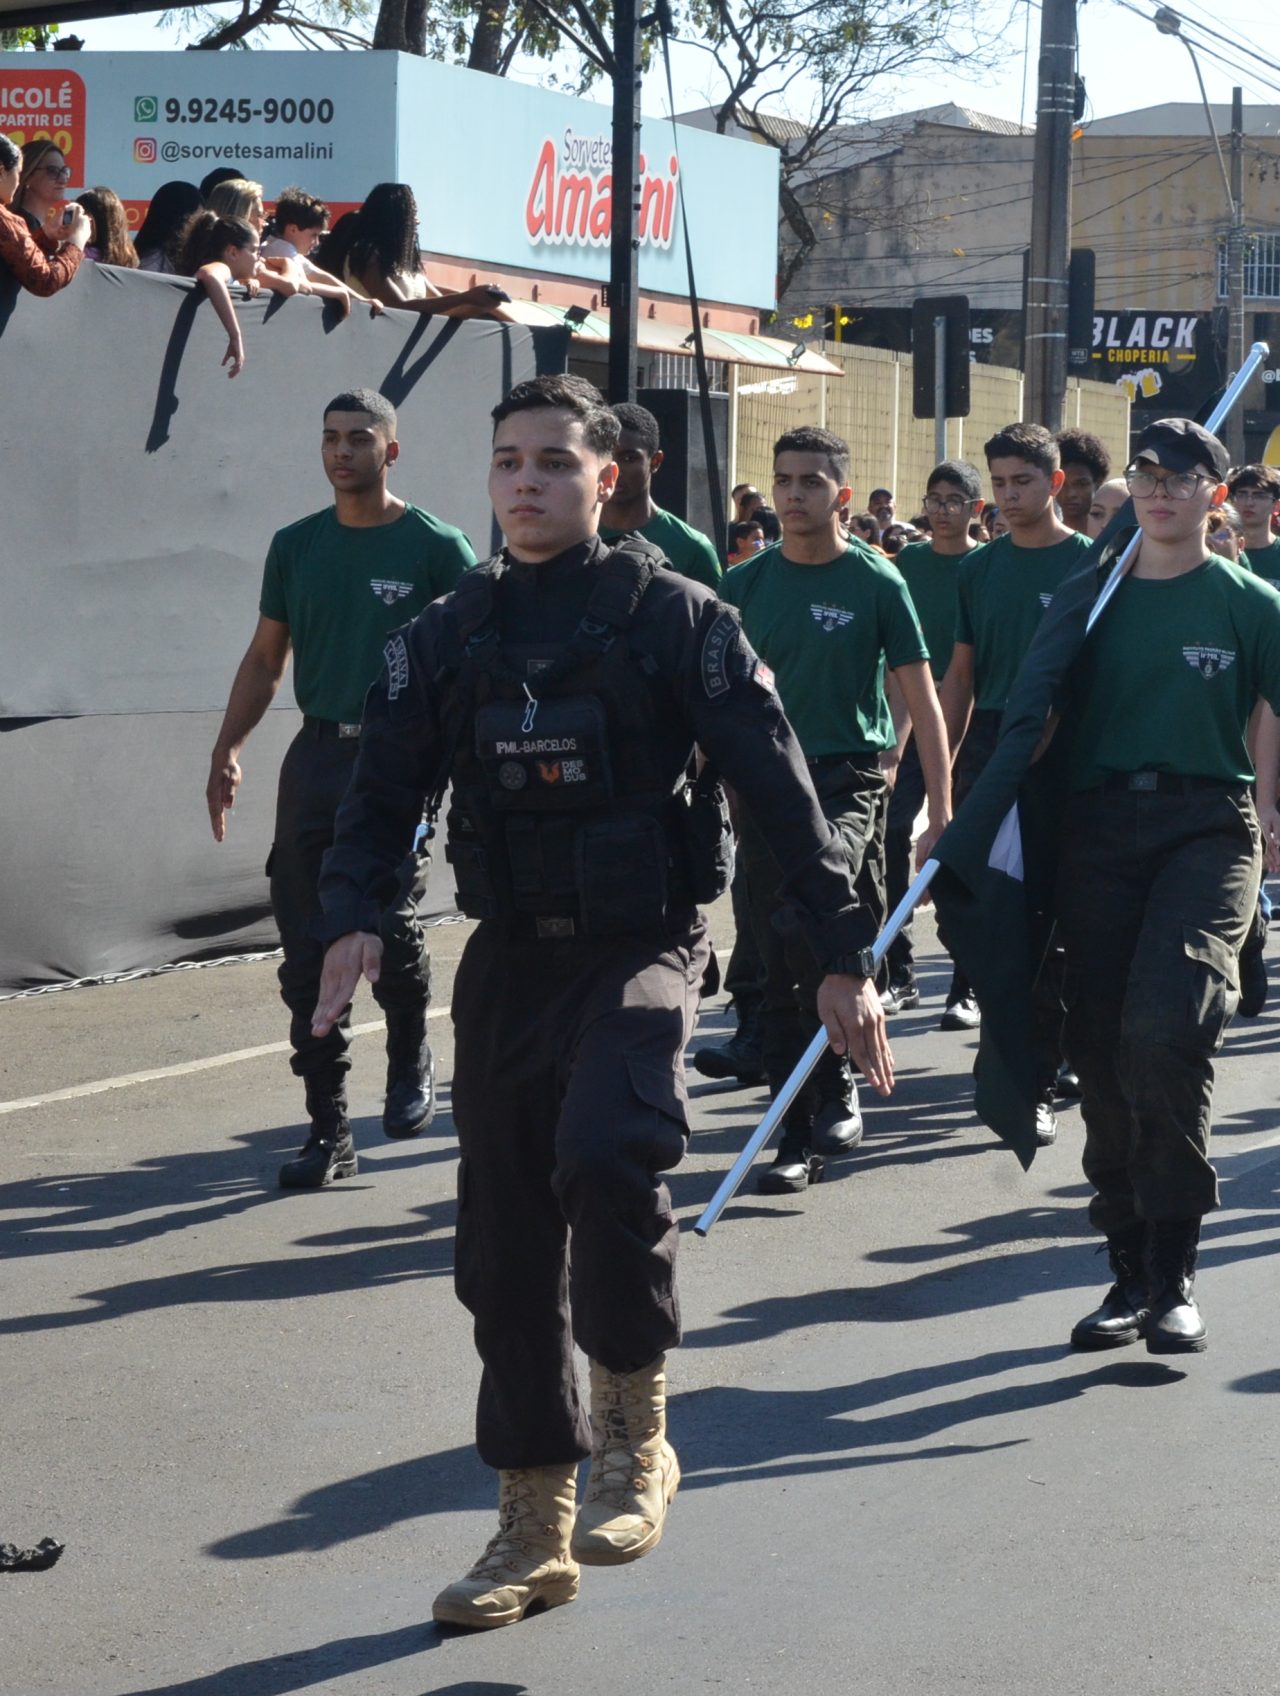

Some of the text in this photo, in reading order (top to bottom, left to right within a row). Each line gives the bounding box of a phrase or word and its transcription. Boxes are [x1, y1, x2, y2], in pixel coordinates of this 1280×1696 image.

[53, 114, 72, 127] DE
[165, 97, 334, 124] 9.9245-9000
[161, 141, 333, 163] @sorvetesamalini
[526, 140, 678, 242] Amani
[1092, 316, 1199, 348] BLACK
[1108, 349, 1170, 363] CHOPERIA
[707, 621, 733, 688] BRASIL
